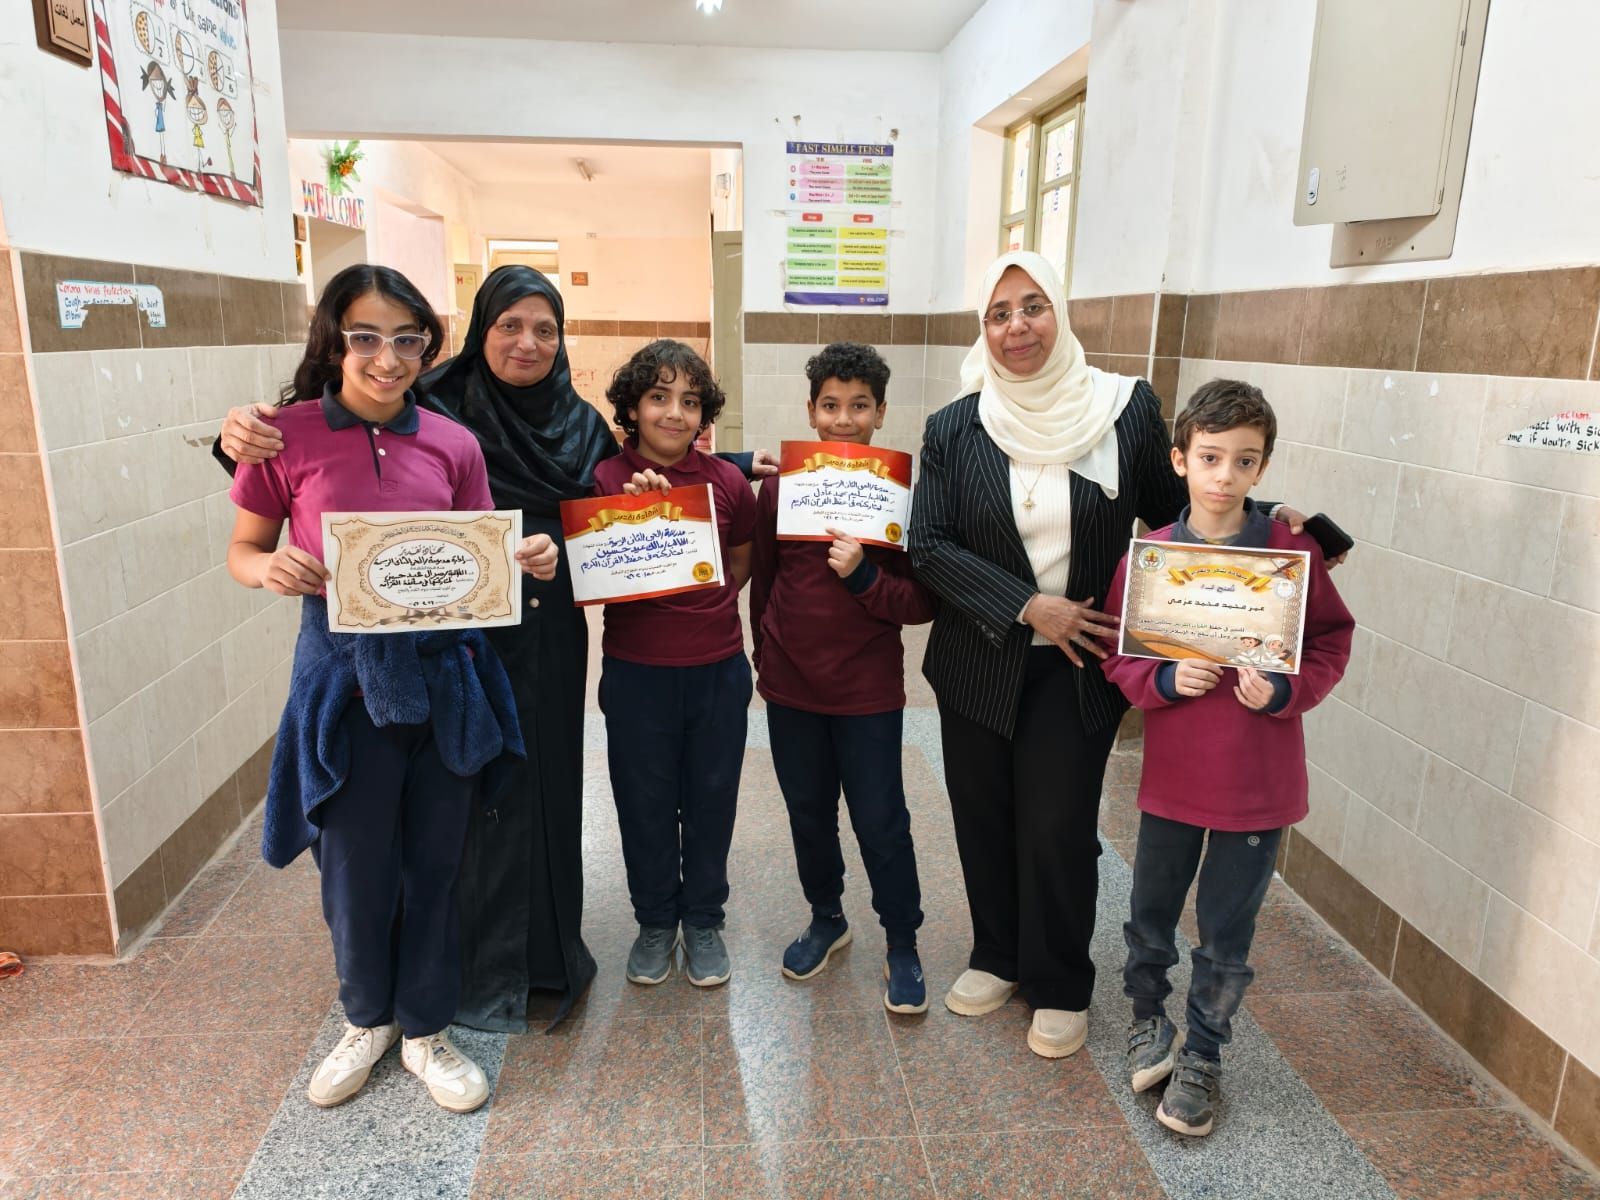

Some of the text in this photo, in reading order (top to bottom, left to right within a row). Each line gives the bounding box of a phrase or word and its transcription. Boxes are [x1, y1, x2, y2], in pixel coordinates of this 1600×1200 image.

[54, 3, 85, 28] معمل لغات
[197, 14, 217, 38] same
[822, 144, 855, 154] SIMPLE
[857, 145, 886, 155] TENSE
[302, 180, 365, 227] WELCOME
[1557, 420, 1581, 435] with
[1529, 432, 1538, 444] if
[596, 546, 631, 558] حسين
[580, 558, 601, 574] الكريم
